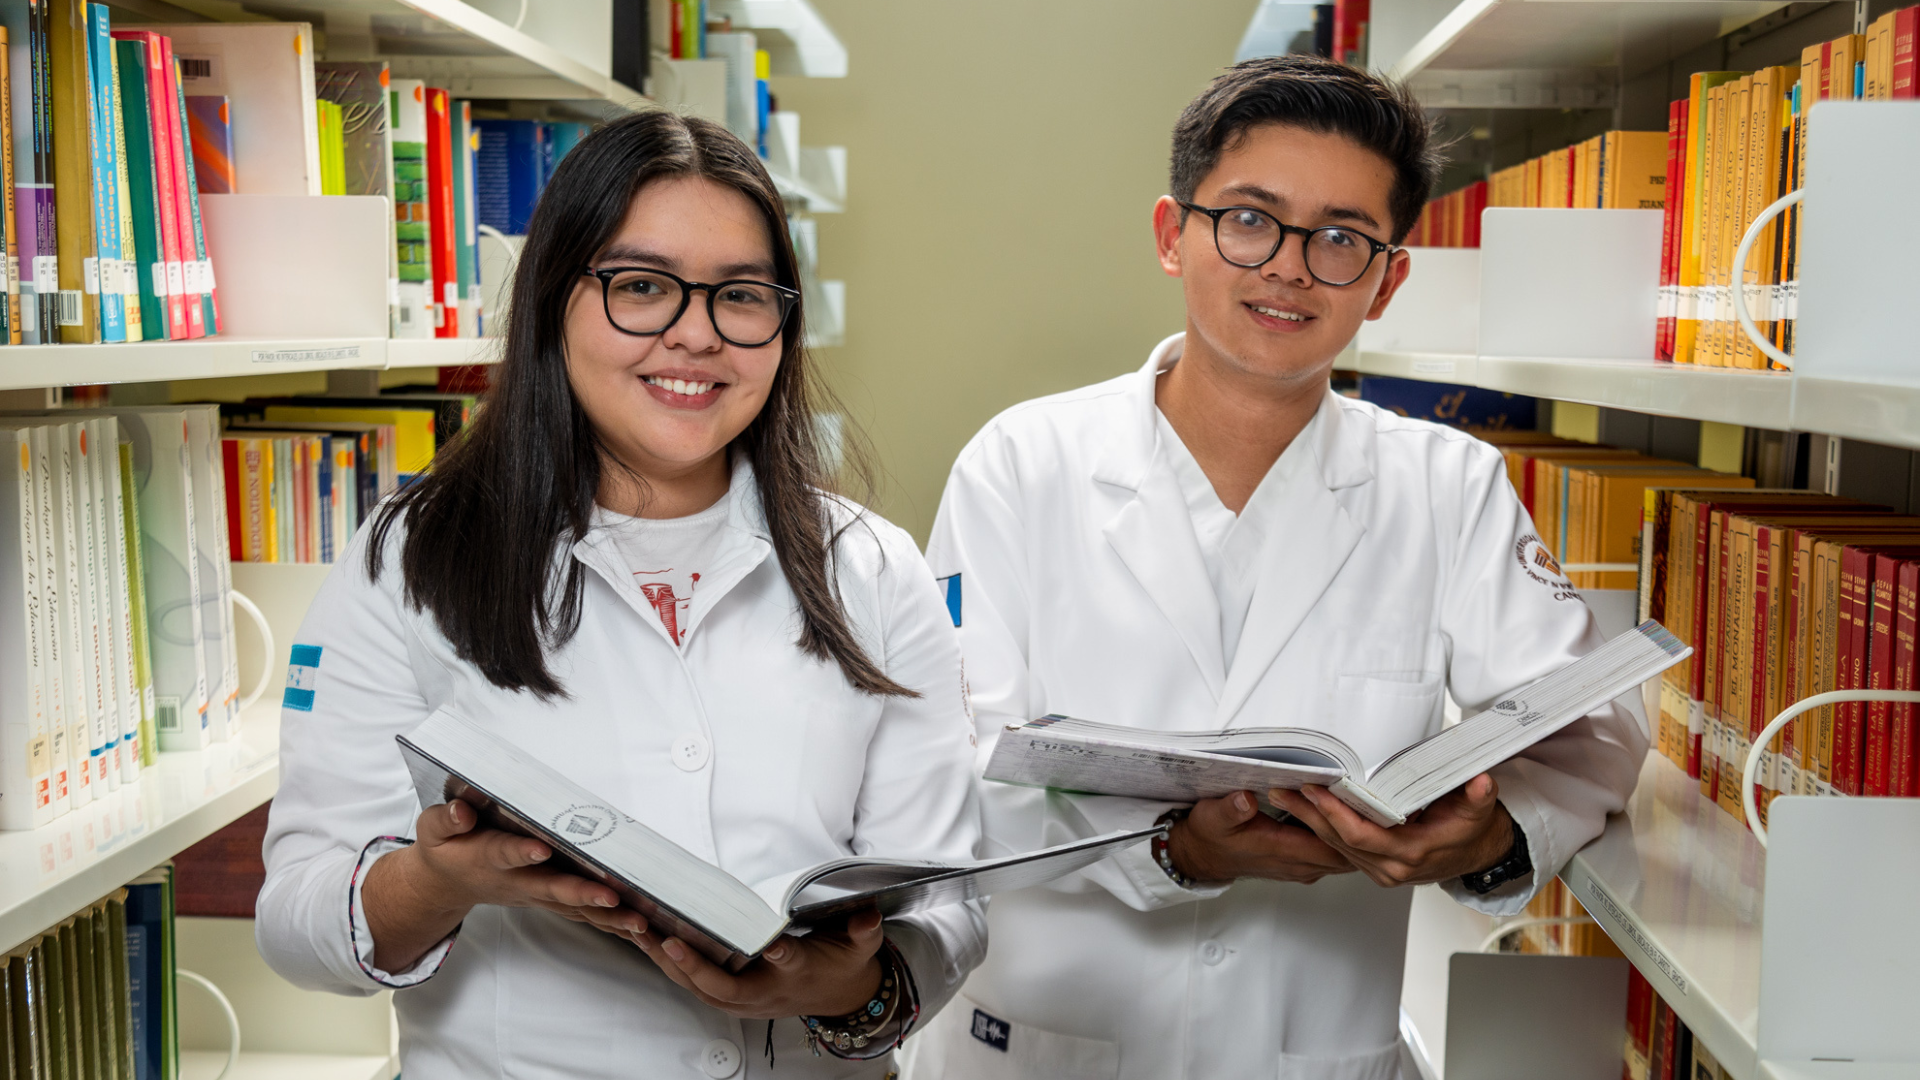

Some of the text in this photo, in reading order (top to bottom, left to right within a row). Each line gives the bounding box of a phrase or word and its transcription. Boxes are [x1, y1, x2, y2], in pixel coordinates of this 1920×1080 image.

[103, 85, 112, 163] educativa
[5, 133, 13, 212] DIDÁCTICA
[1638, 199, 1666, 209] JUAN
[1649, 175, 1667, 185] PEP
[1724, 151, 1734, 221] TEATRO
[1734, 177, 1743, 247] ROBINSON
[63, 448, 80, 654] Psicología de la Educación
[85, 502, 95, 587] Psicología
[100, 498, 110, 581] Psicología
[118, 495, 127, 577] Psicología
[250, 478, 262, 550] EDUCATION
[21, 468, 40, 668] Psicología de la Educación
[40, 451, 57, 661] Psicología de la Educación
[1876, 579, 1892, 592] SEPAN
[92, 607, 97, 622] LA
[106, 601, 112, 616] LA
[124, 597, 130, 611] LA
[1732, 553, 1743, 696] EL MONASTERIO
[93, 623, 103, 711] EDUCACIÓN
[108, 618, 118, 702] EDUCACIÓN
[125, 612, 136, 696] EDUCACIÓN
[1813, 609, 1822, 691] ABIOLA
[1835, 654, 1847, 784] LA CIUDAELA
[1870, 714, 1877, 731] LA
[1871, 671, 1880, 712] GLRIA
[1891, 665, 1904, 785] MUNDO FLIZ
[1849, 726, 1857, 770] LLAVES
[1875, 736, 1883, 788] CAMINOS
